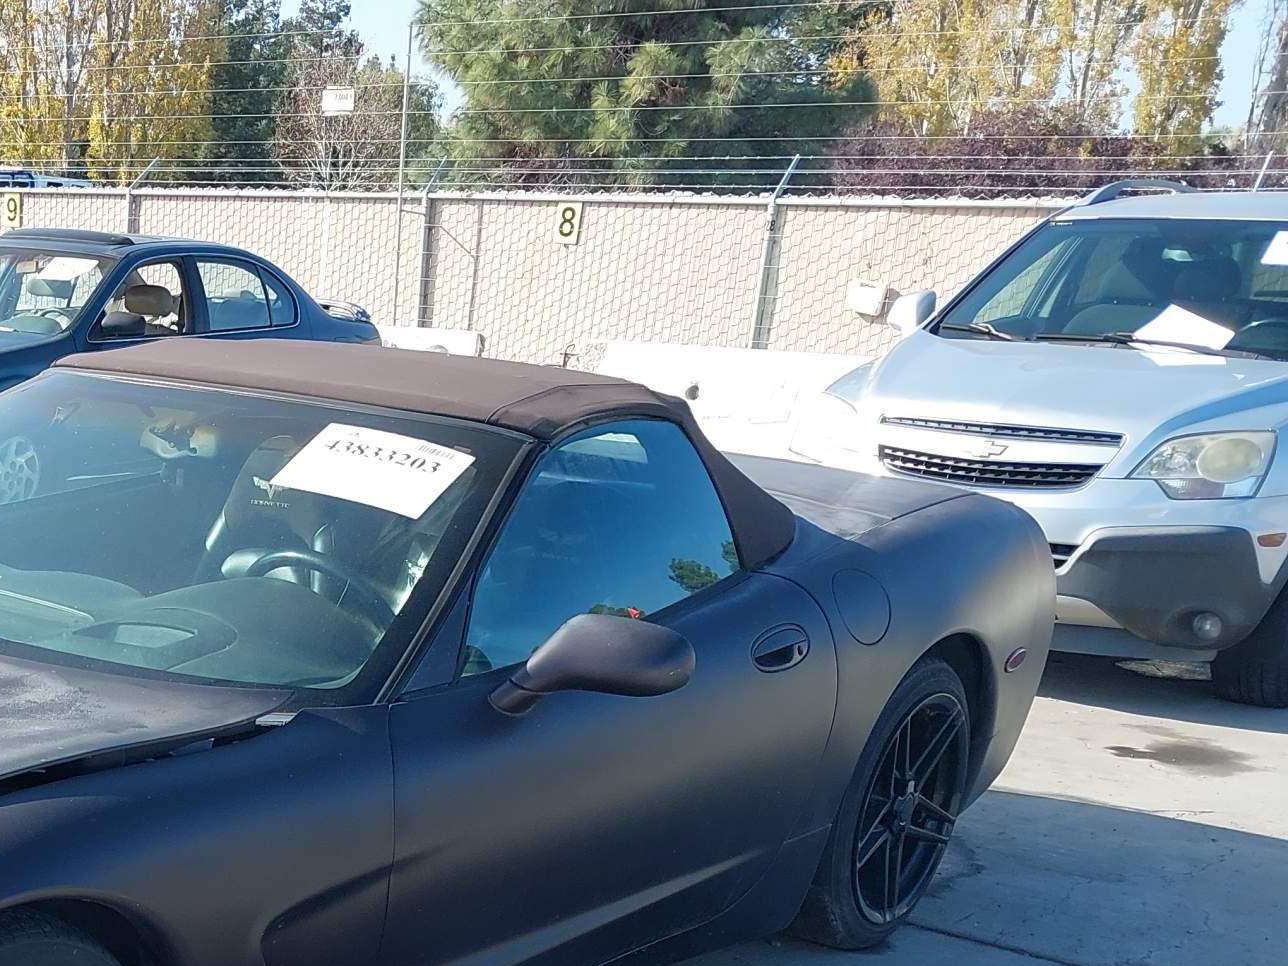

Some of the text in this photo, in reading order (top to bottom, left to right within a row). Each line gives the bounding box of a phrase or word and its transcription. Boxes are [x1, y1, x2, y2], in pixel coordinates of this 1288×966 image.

[7, 197, 17, 221] 9
[559, 206, 576, 237] 8
[324, 439, 441, 473] 43833203
